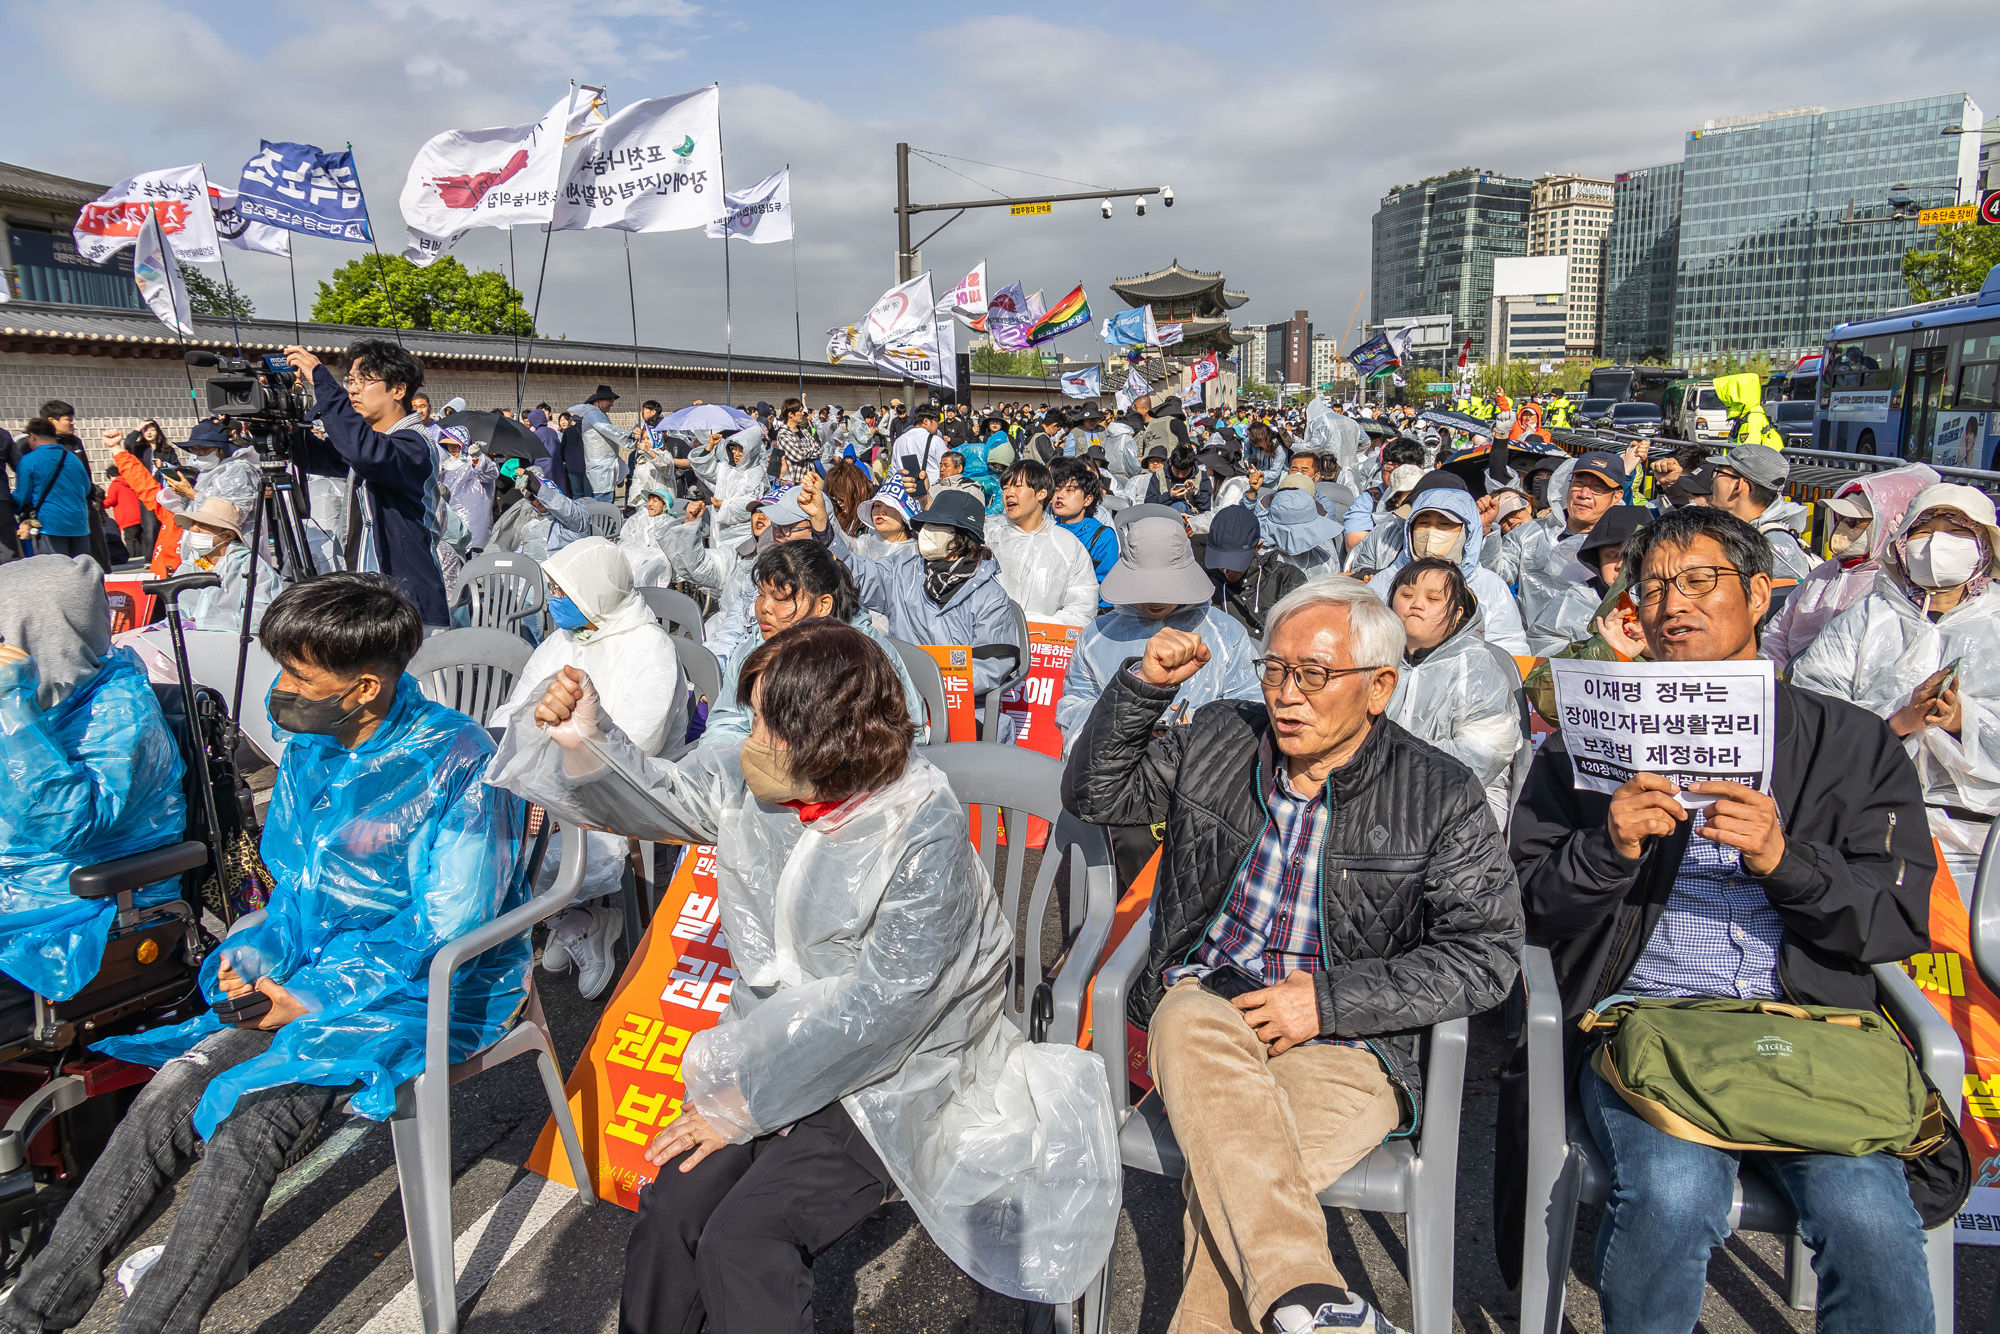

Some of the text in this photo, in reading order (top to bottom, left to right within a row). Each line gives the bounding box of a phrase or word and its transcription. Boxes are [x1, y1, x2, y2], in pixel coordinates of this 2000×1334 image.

[1702, 127, 1732, 136] Microsoft
[1922, 208, 1974, 222] 과속단속장비
[1923, 329, 1940, 348] 171
[1044, 657, 1068, 670] 나라
[1584, 679, 1729, 703] 이재명 정부는
[1565, 705, 1759, 735] 장애인자립생활권리
[1583, 737, 1741, 768] 보장법 제정하라
[1757, 1043, 1793, 1053] AIGLE
